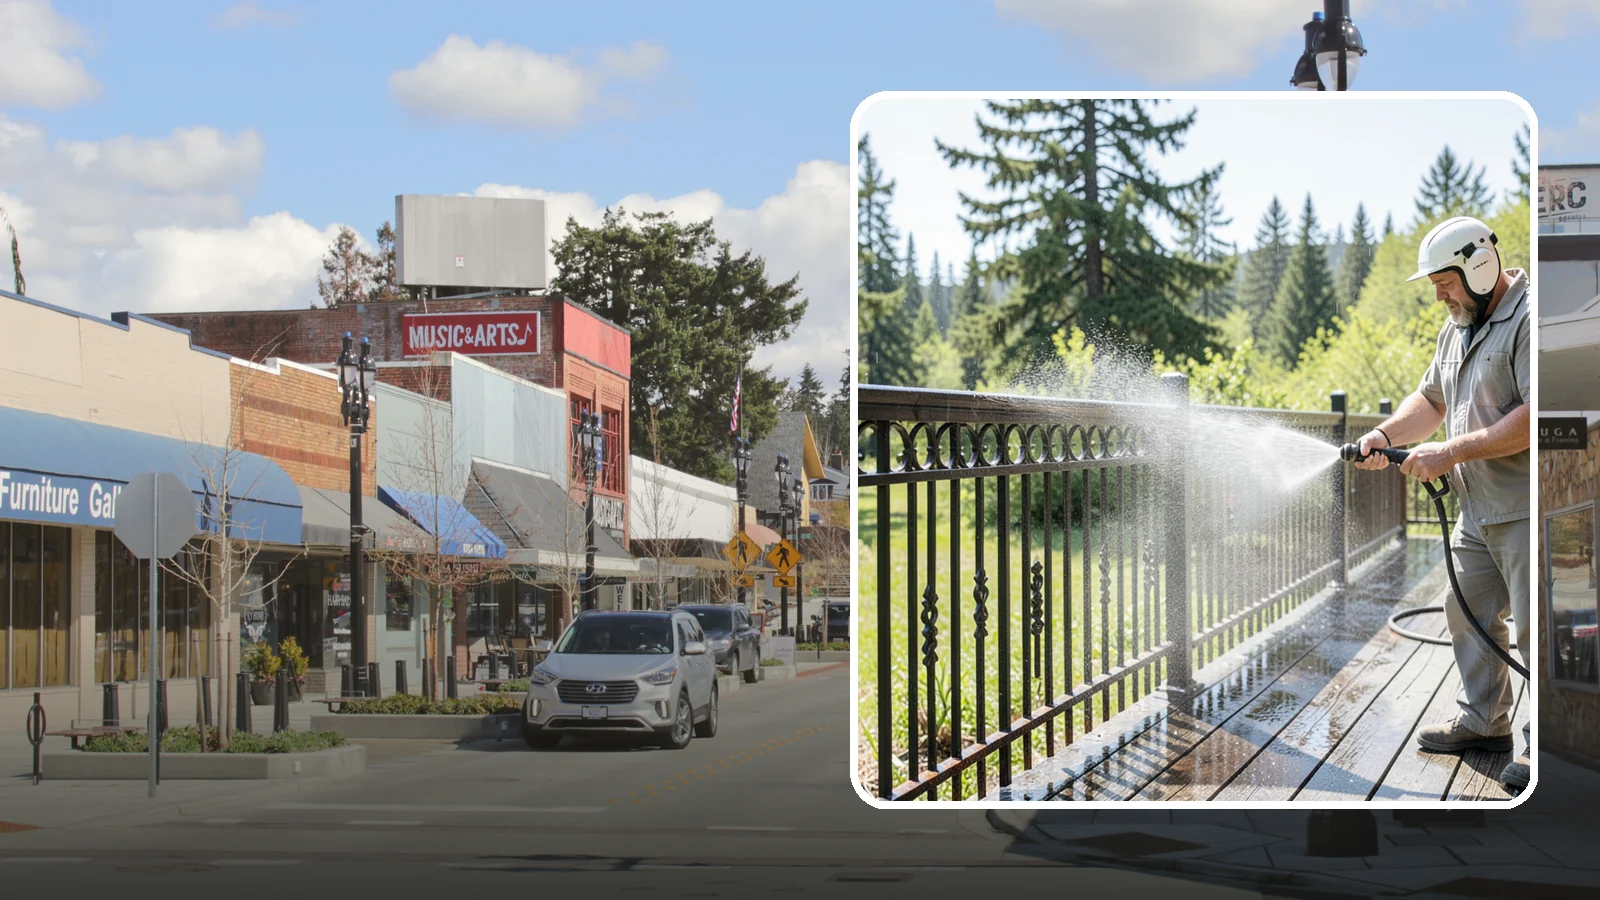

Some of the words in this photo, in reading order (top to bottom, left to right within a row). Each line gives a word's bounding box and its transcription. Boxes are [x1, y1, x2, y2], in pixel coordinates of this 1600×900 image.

[1540, 427, 1577, 437] UGA
[0, 471, 80, 516] Furniture
[89, 482, 122, 519] Gal
[452, 562, 479, 574] SUSHI
